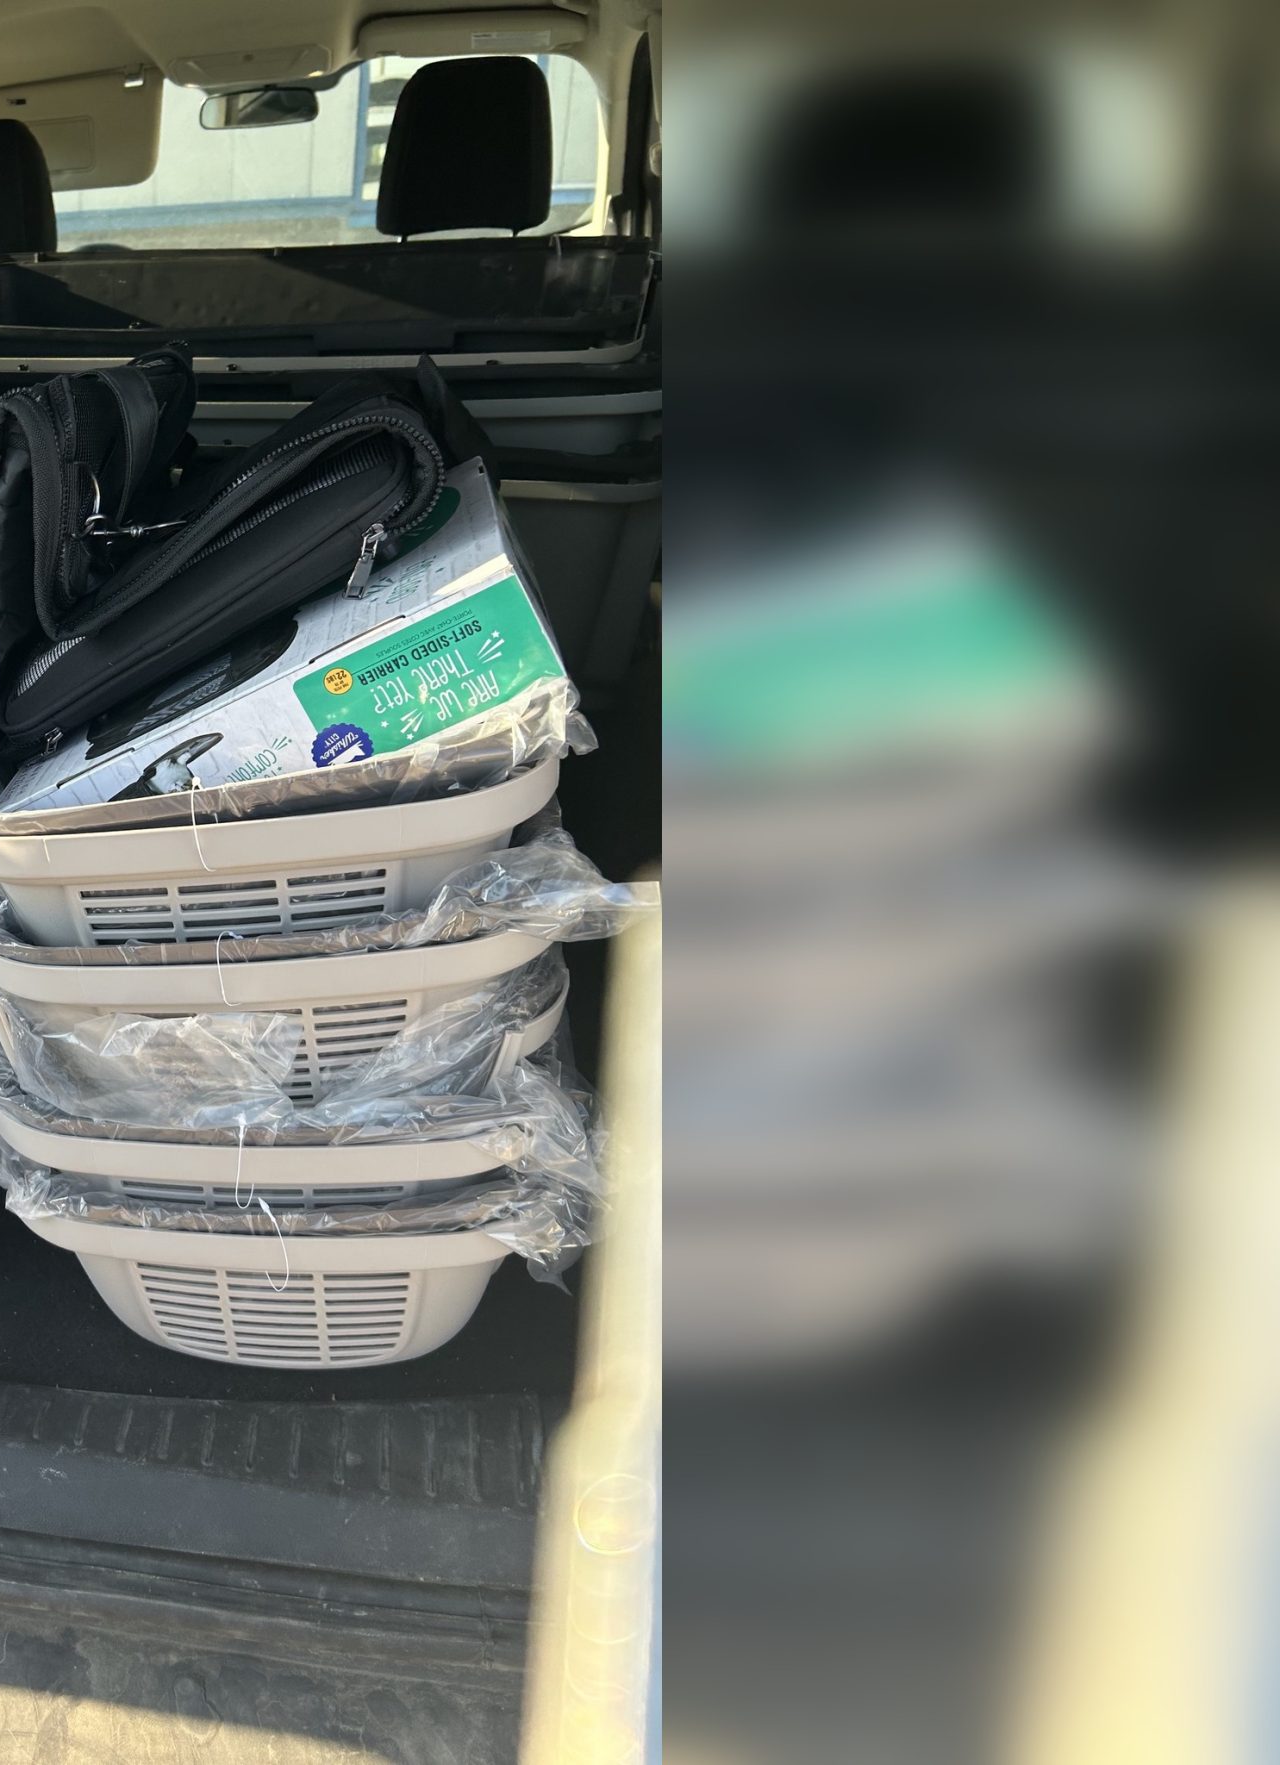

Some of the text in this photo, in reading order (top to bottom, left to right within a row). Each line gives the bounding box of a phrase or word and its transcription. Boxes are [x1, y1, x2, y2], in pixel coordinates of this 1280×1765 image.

[358, 619, 482, 686] SOFT-SIDED CARRIER
[325, 669, 347, 683] 22 LBS
[321, 731, 359, 760] Whisker
[325, 732, 339, 748] CITY
